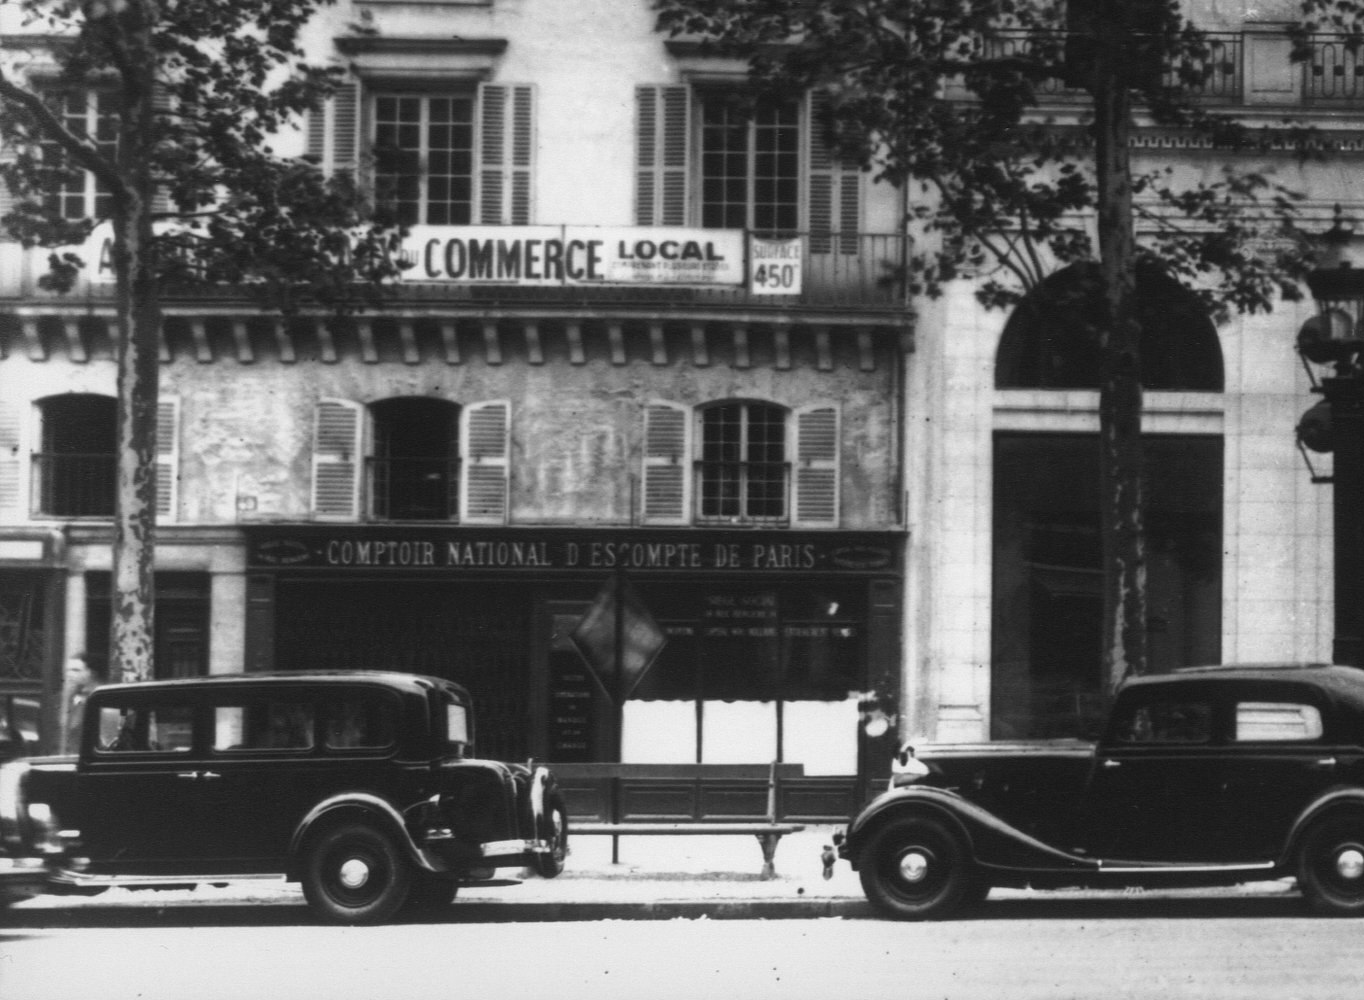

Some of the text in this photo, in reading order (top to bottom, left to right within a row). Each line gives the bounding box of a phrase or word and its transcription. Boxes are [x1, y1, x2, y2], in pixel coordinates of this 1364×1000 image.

[424, 238, 604, 280] COMMERCE
[618, 239, 725, 262] LOCAL
[328, 540, 435, 566] COMPTOIR
[447, 541, 552, 567] NATIONAL
[714, 543, 740, 568] DE
[752, 543, 816, 569] PARIS
